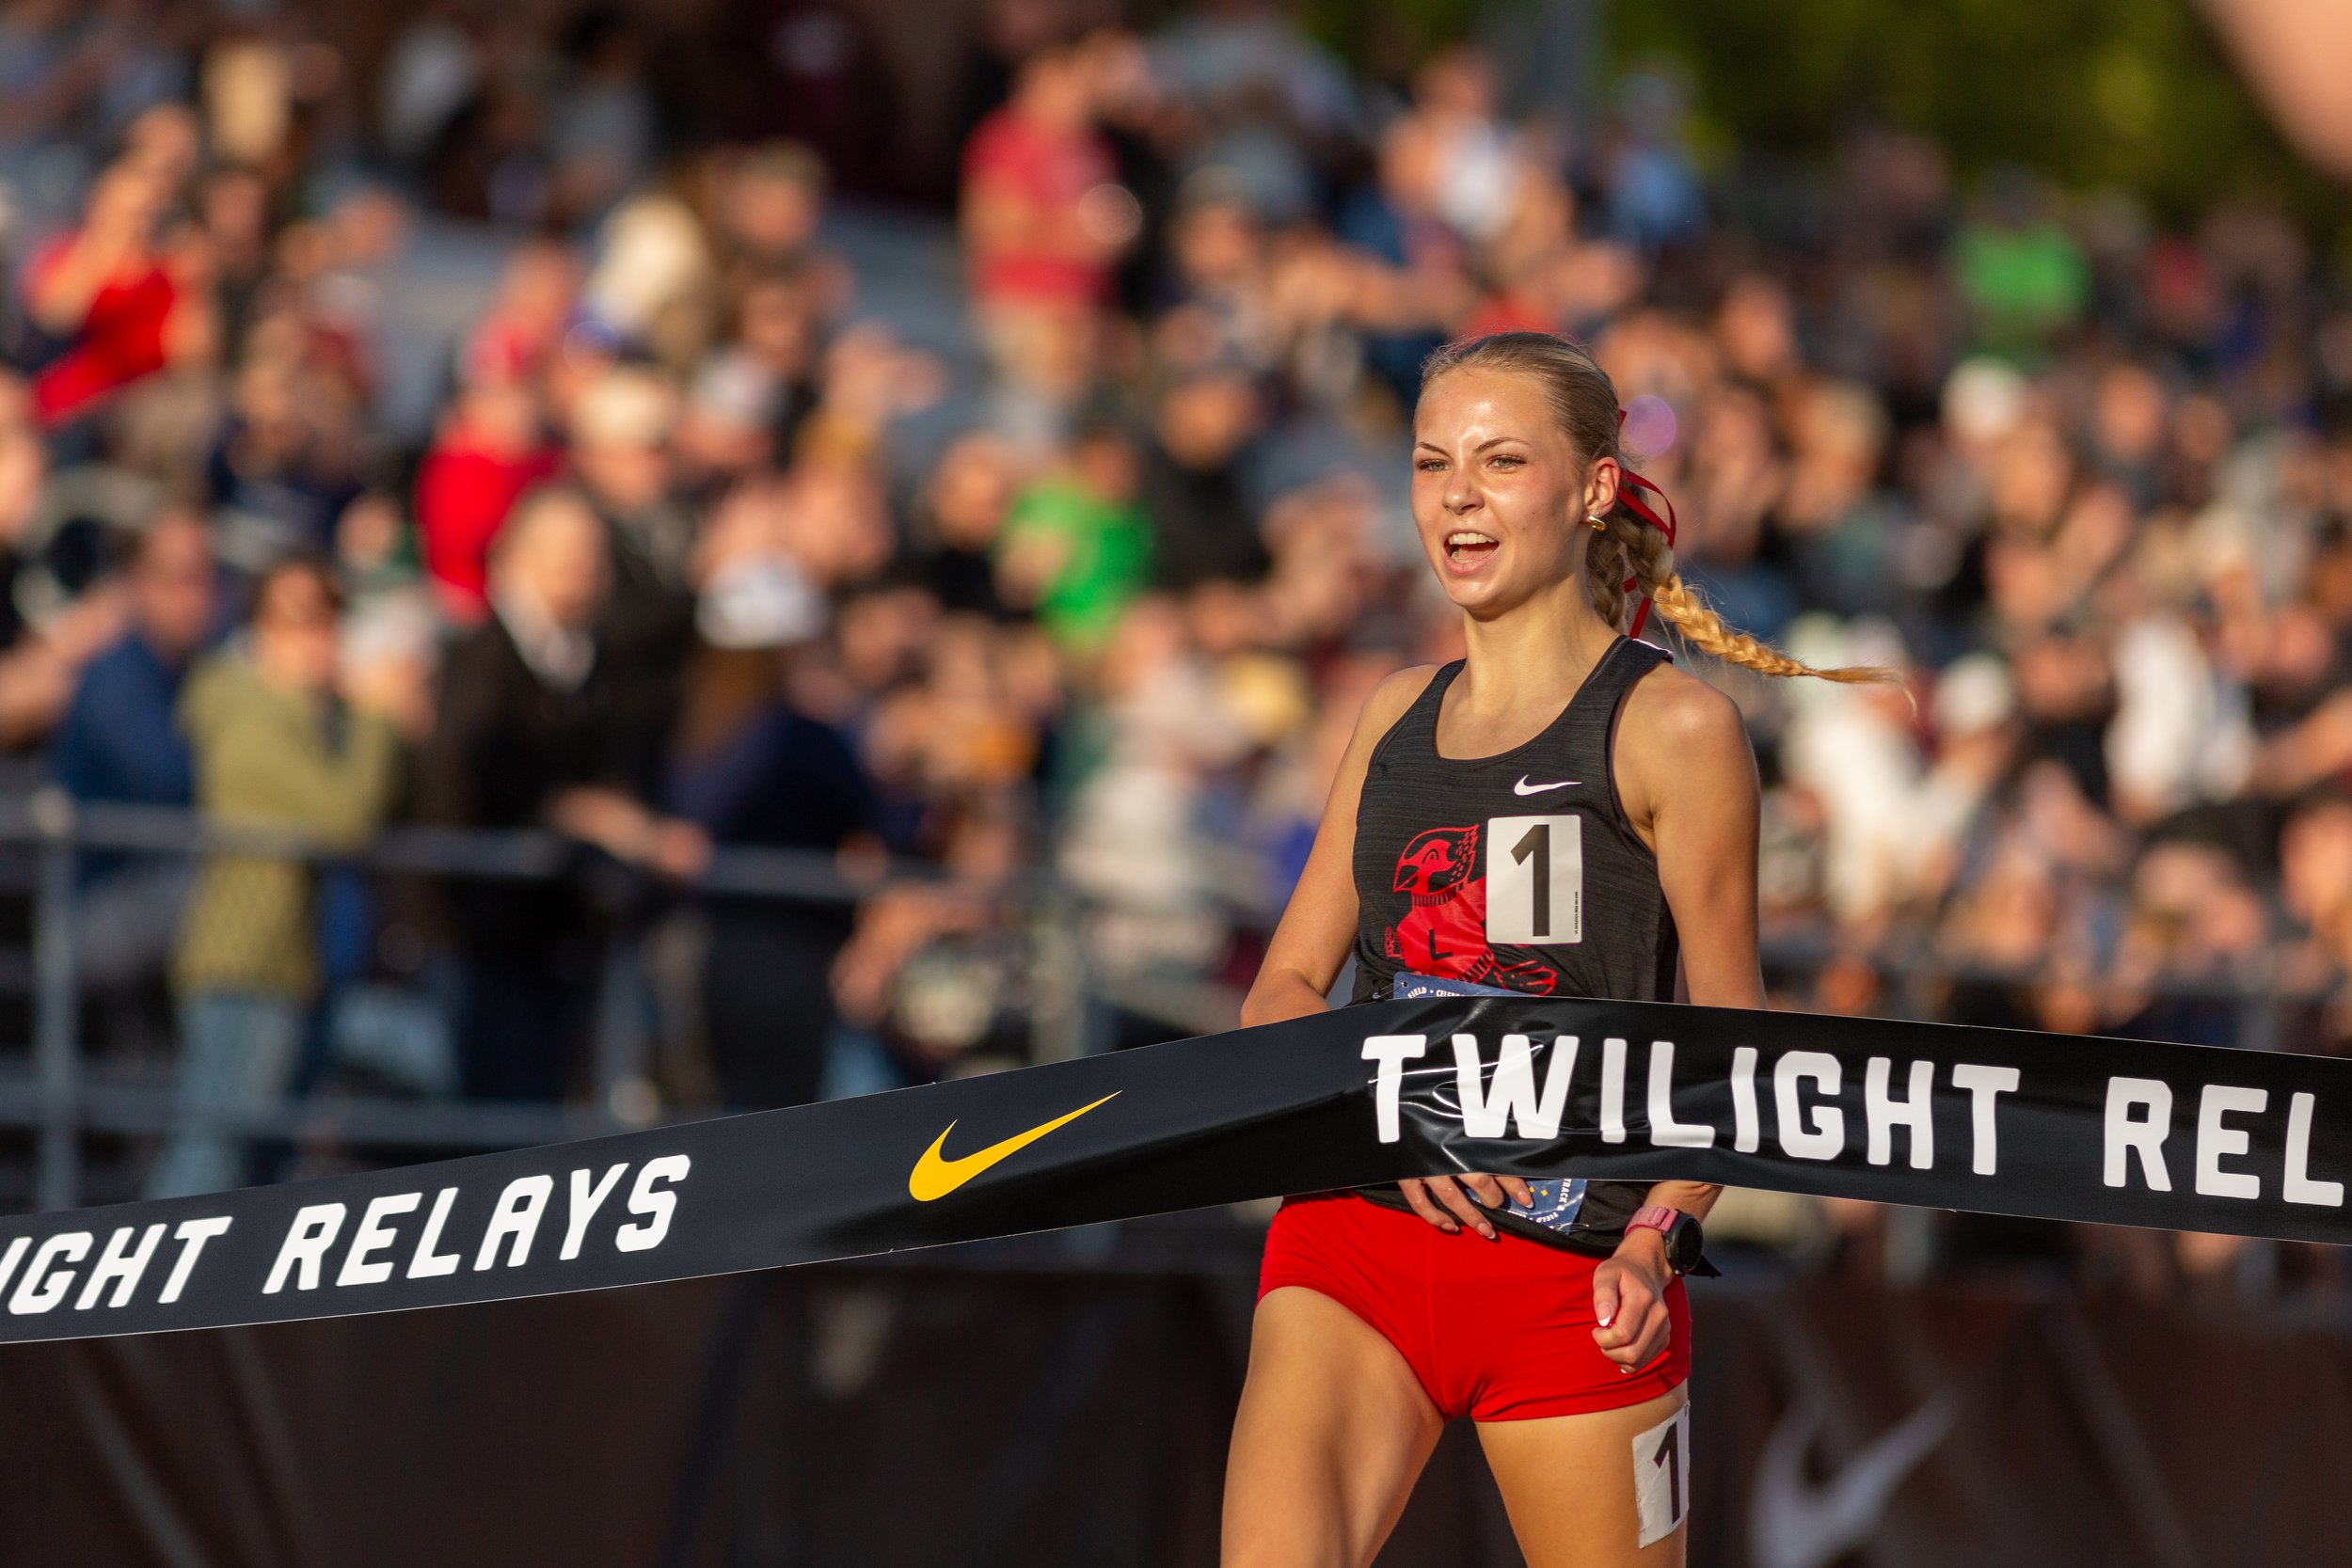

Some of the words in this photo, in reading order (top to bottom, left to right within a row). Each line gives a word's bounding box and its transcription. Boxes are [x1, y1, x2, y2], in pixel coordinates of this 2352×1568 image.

[1511, 824, 1550, 937] 1
[1407, 986, 1427, 999] FIELD
[1429, 928, 1454, 960] L
[1360, 1033, 2020, 1176] TWILIGHT
[2103, 1076, 2344, 1207] REL
[262, 1154, 691, 1294] RELAYS
[1558, 1178, 1572, 1203] TRACK
[1653, 1421, 1681, 1525] 1
